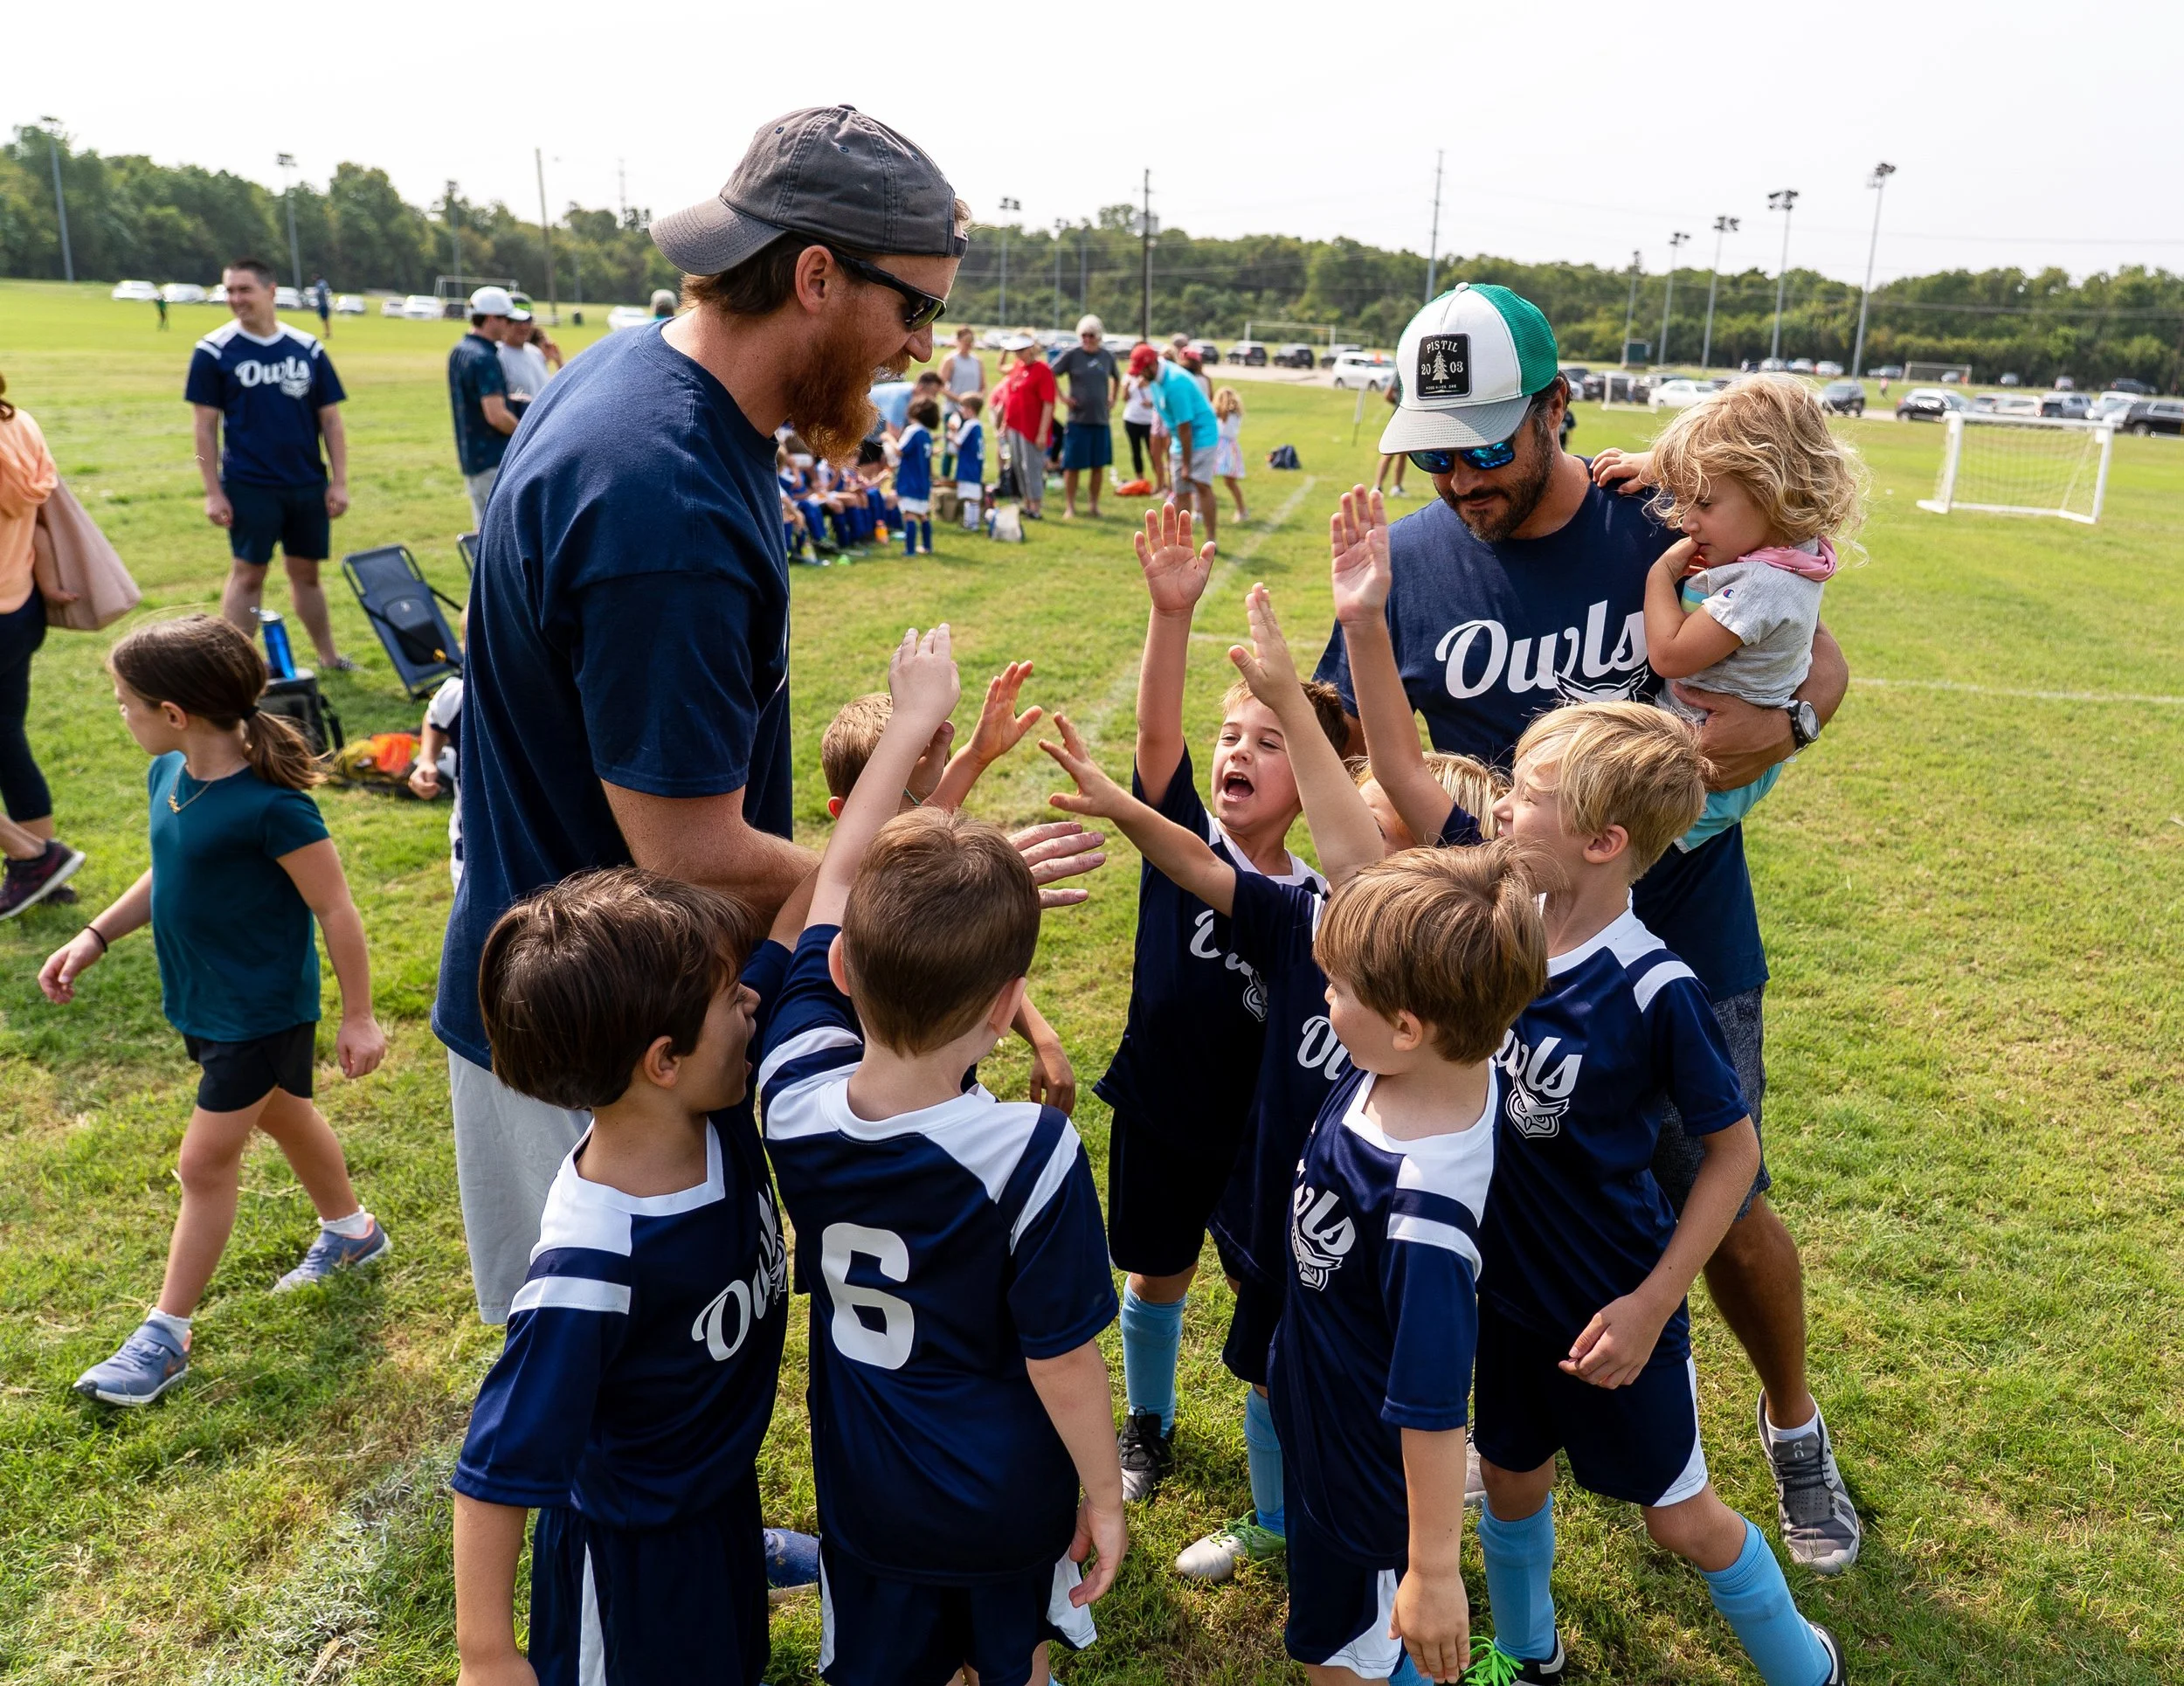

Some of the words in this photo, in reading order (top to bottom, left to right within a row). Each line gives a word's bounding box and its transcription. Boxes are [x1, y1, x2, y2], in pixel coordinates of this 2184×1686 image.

[234, 355, 310, 388] Owls
[1420, 363, 1431, 376] 20
[1449, 361, 1463, 373] 03
[1426, 340, 1458, 354] PISTIL
[1435, 599, 1648, 699] Owls
[1495, 1028, 1582, 1098] wls
[821, 1222, 915, 1370] 6
